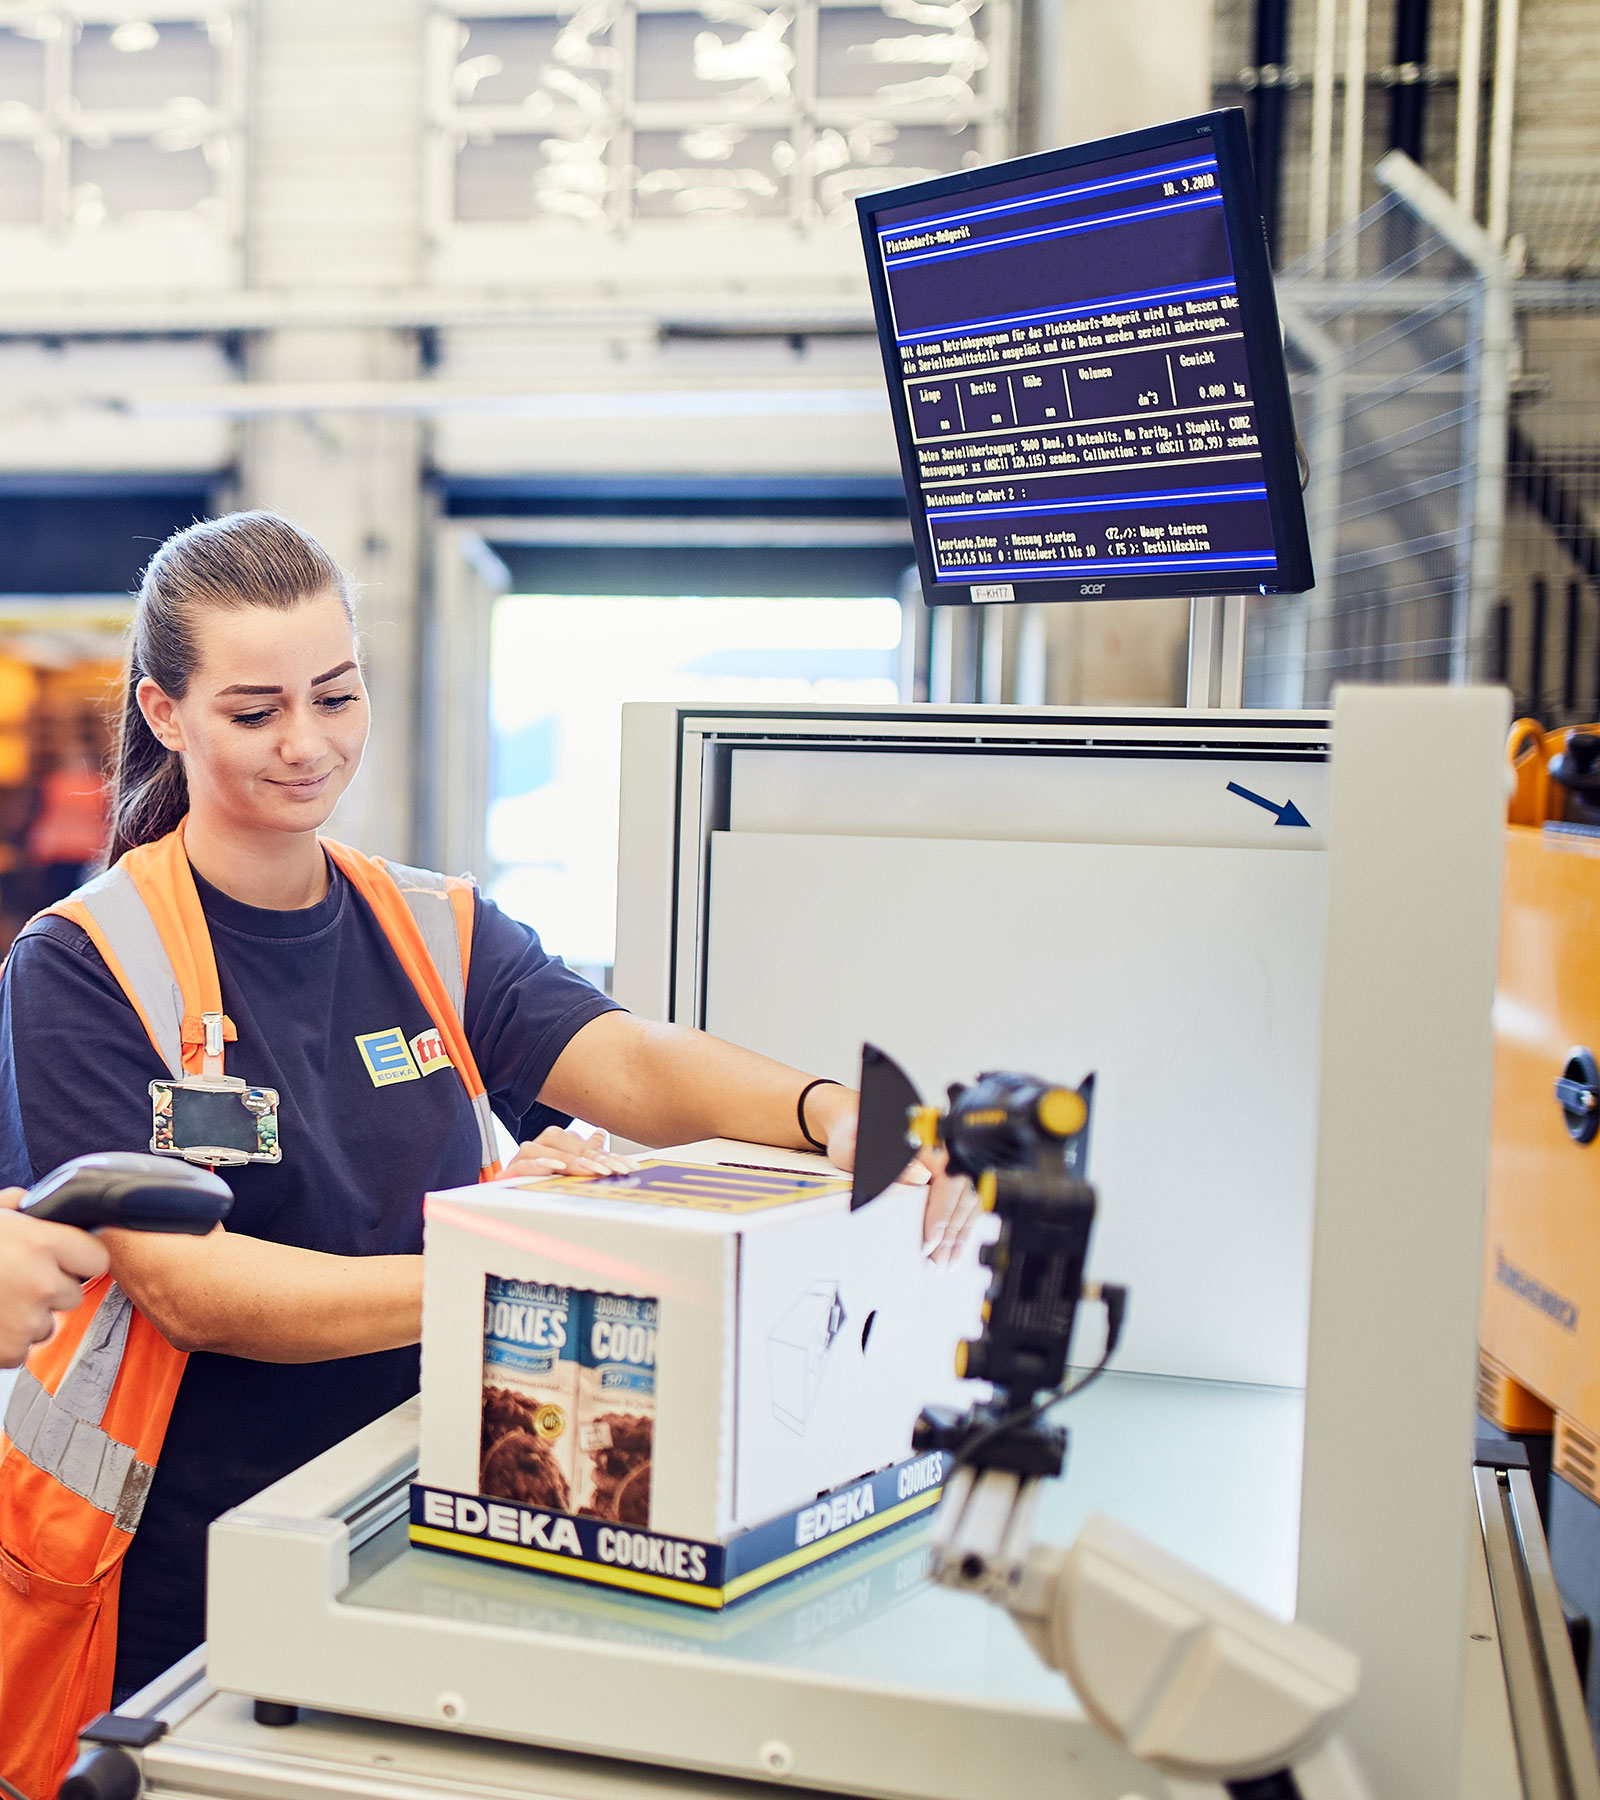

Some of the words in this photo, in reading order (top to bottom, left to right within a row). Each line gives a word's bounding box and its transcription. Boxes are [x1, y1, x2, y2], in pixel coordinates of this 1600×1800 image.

[1163, 182, 1179, 196] 18.
[1181, 173, 1215, 192] 9.2018
[900, 346, 914, 359] Mit
[1011, 329, 1026, 342] für
[1028, 326, 1043, 339] das
[1143, 306, 1164, 321] wird
[1167, 305, 1184, 318] das
[1186, 300, 1218, 315] Messen
[903, 361, 917, 374] die
[1002, 343, 1041, 360] ausgelöst
[1044, 339, 1059, 353] und
[1061, 338, 1076, 350] die
[1078, 334, 1103, 348] Daten
[1105, 330, 1134, 344] werden
[1137, 322, 1171, 339] seriell
[1174, 317, 1230, 334] übertragen.
[919, 389, 941, 404] Länge
[970, 382, 997, 396] Breite
[1022, 374, 1043, 389] Höhe
[1078, 367, 1113, 381] Volumen
[1179, 351, 1215, 368] Gewicht
[1198, 384, 1226, 399] 0.000
[1233, 381, 1246, 398] kg
[918, 450, 940, 463] Daten
[1020, 438, 1040, 452] 9600
[1041, 436, 1065, 450] Baud,
[1067, 434, 1074, 447] 8
[1076, 430, 1122, 446] Datenbits,
[1124, 428, 1136, 441] No
[1138, 425, 1172, 440] Parity,
[1176, 423, 1183, 436] 1
[1185, 418, 1225, 436] Stopbit,
[1228, 416, 1252, 430] COM2
[983, 457, 1008, 471] (ASCII
[1011, 453, 1046, 469] 120,115)
[1049, 451, 1080, 465] senden,
[1083, 444, 1138, 462] Calibration:
[1140, 444, 1153, 456] xc
[1156, 439, 1184, 455] (ASCII
[1187, 435, 1223, 452] 120,99)
[1227, 433, 1259, 448] senden
[925, 491, 974, 507] Datatransfer
[1008, 487, 1015, 500] 2
[1011, 533, 1042, 547] Messung
[1044, 530, 1076, 543] starten
[1139, 525, 1165, 540] Waage
[1168, 523, 1208, 536] tarieren
[978, 550, 993, 563] bis
[1013, 547, 1058, 561] Mittelwert
[1060, 546, 1066, 559] 1
[1068, 545, 1083, 558] bis
[1085, 544, 1097, 557] 10
[1080, 583, 1106, 595] acer
[377, 1068, 415, 1081] EDEKA
[508, 1281, 569, 1306] CHOCOLATE
[597, 1297, 640, 1318] DOUBLE
[796, 1483, 876, 1547] EDEKA
[897, 1450, 943, 1500] COOKIES
[423, 1489, 584, 1556] EDEKA
[598, 1526, 708, 1582] COOKIES
